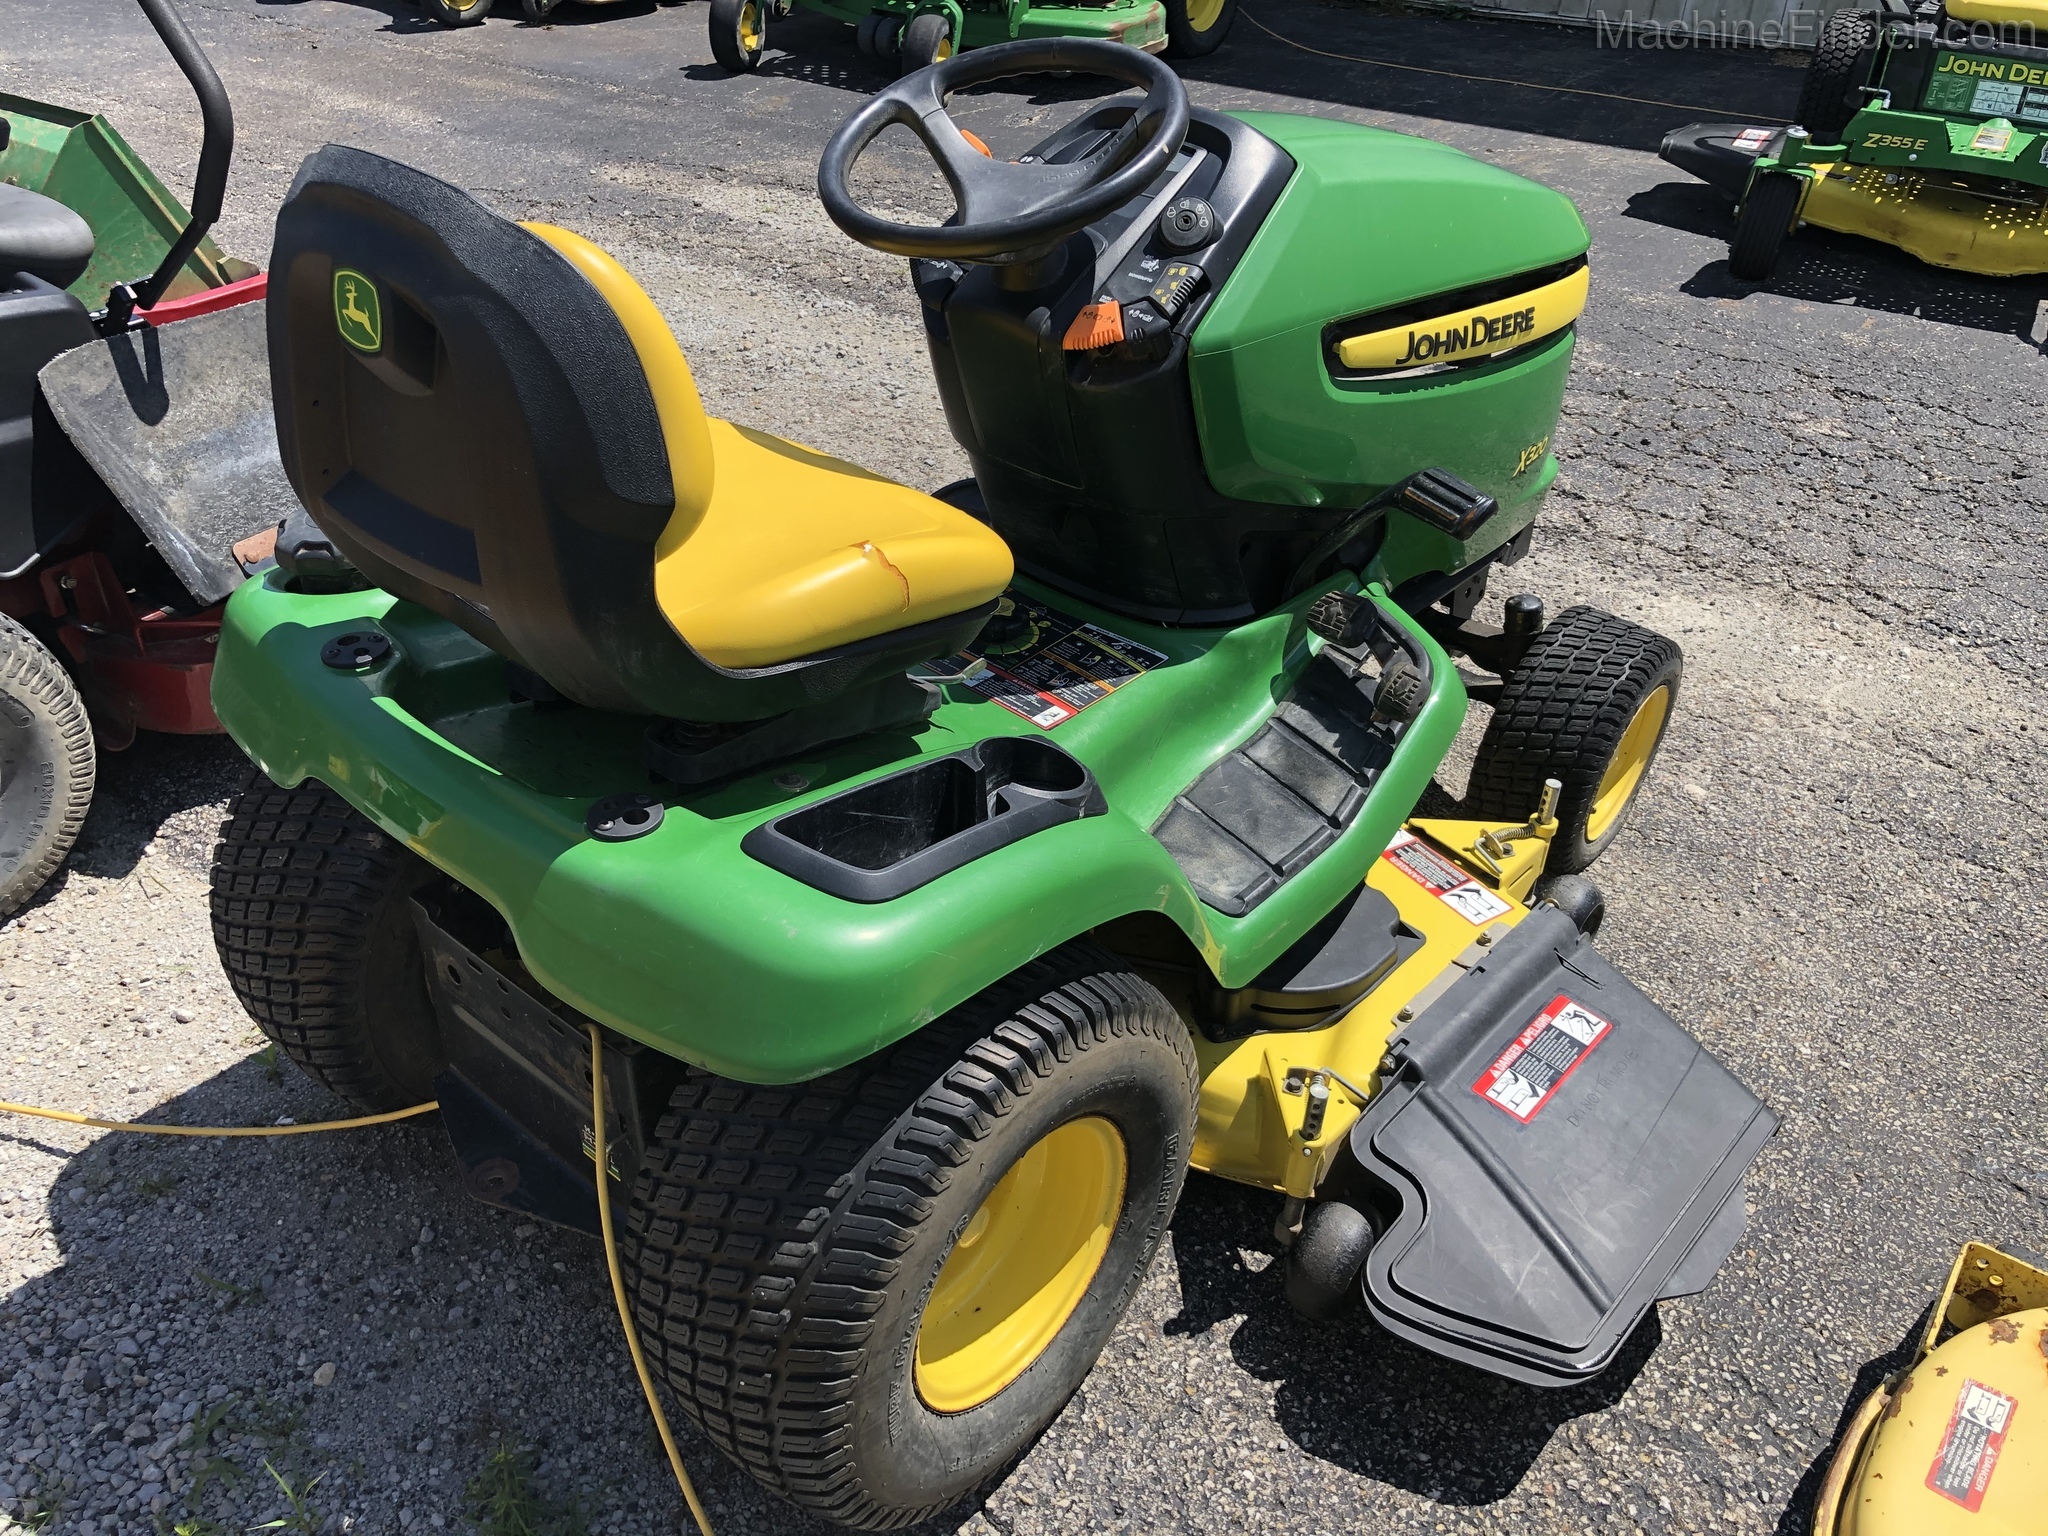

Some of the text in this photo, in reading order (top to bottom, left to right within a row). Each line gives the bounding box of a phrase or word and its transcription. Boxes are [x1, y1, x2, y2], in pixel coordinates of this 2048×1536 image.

[1938, 55, 2005, 79] JOHN
[1395, 306, 1536, 365] JOHN DEERE
[1389, 855, 1425, 883] DANGER
[1494, 1042, 1523, 1072] DANGER
[1523, 1012, 1552, 1040] PELIGRO
[1960, 1433, 1986, 1489] ROTATING BLADE
[1974, 1455, 1993, 1491] DANGER
